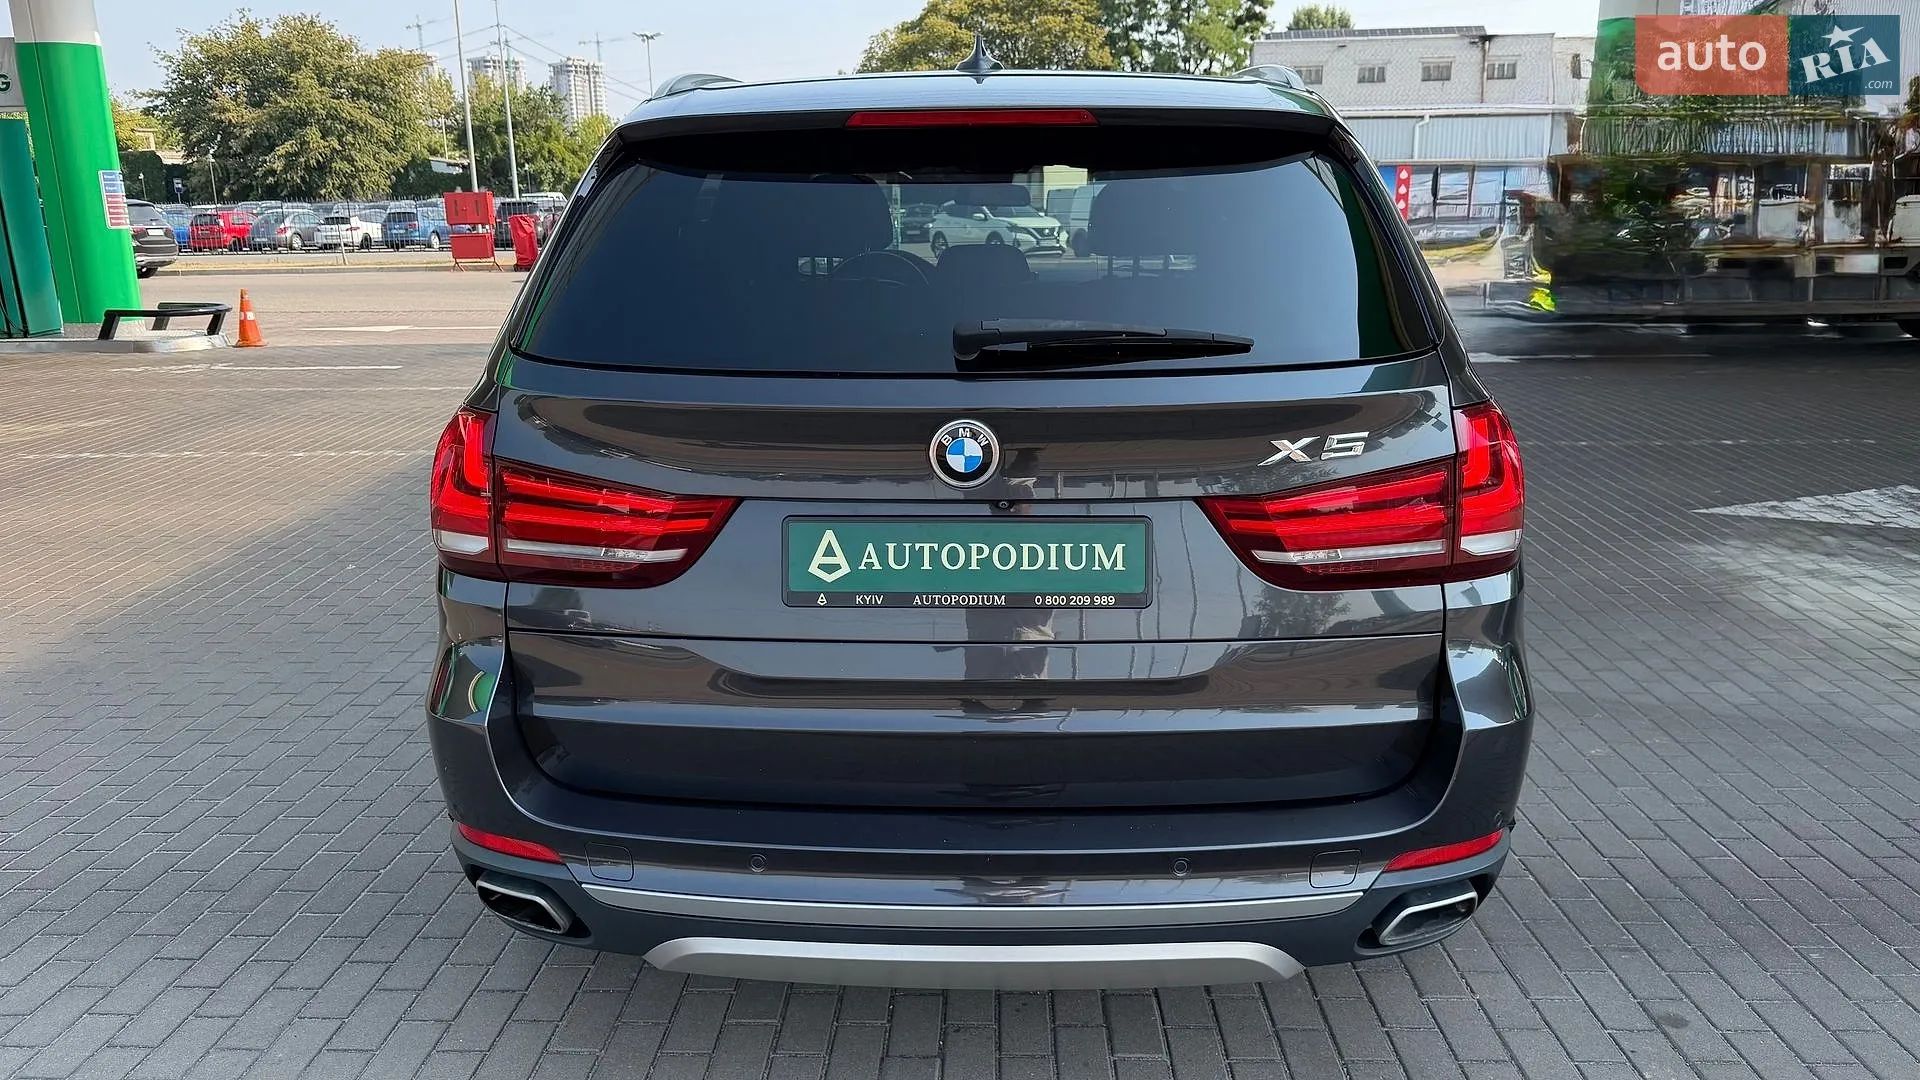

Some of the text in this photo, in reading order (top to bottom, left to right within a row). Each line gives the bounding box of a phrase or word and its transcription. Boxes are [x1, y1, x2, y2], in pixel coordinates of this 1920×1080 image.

[940, 427, 989, 447] BMW
[1257, 431, 1370, 467] X5
[858, 542, 1126, 571] AUTOPODIUM
[855, 594, 1116, 606] KYIV AUTOPODIUM 0 800 209 989
